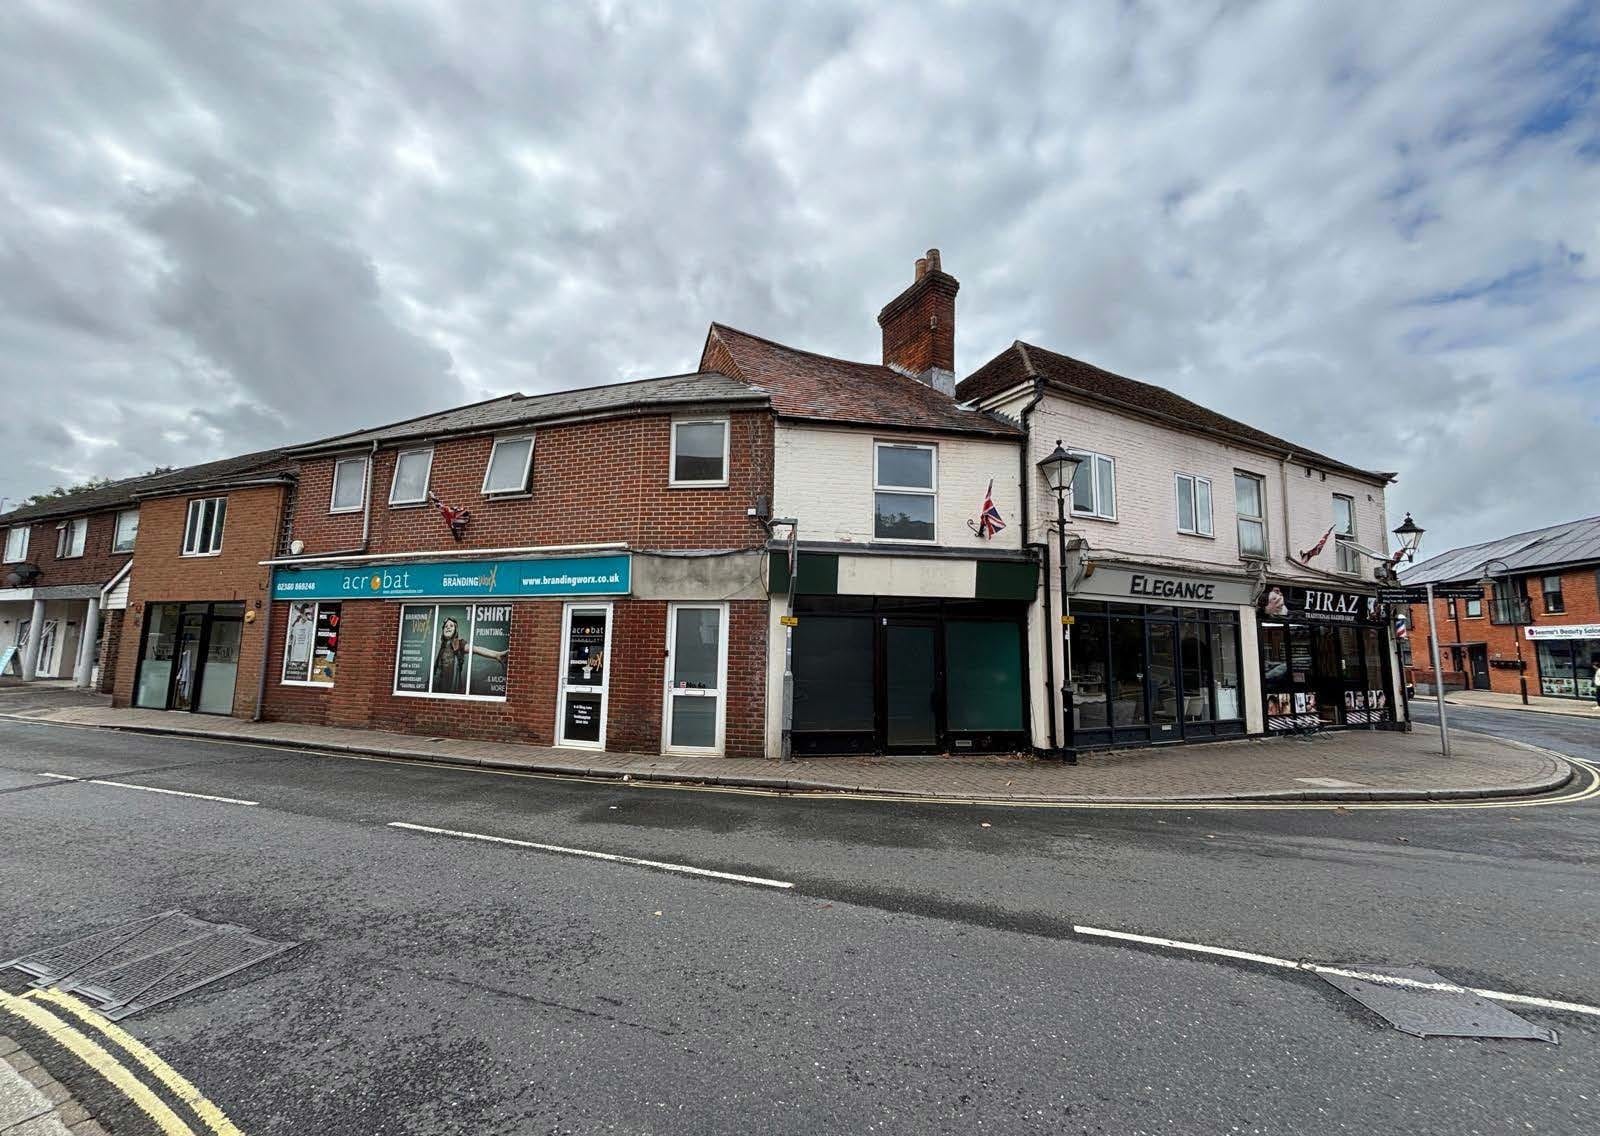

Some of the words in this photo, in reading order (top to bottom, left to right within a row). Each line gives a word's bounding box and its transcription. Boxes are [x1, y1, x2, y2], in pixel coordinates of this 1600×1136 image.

[342, 570, 410, 590] acrobat
[443, 577, 479, 587] BRANDING
[522, 573, 620, 587] www.brandingworx.co.uk
[1304, 590, 1360, 614] FIRAZ
[476, 607, 512, 621] SHIRT
[1560, 628, 1583, 636] Beauty
